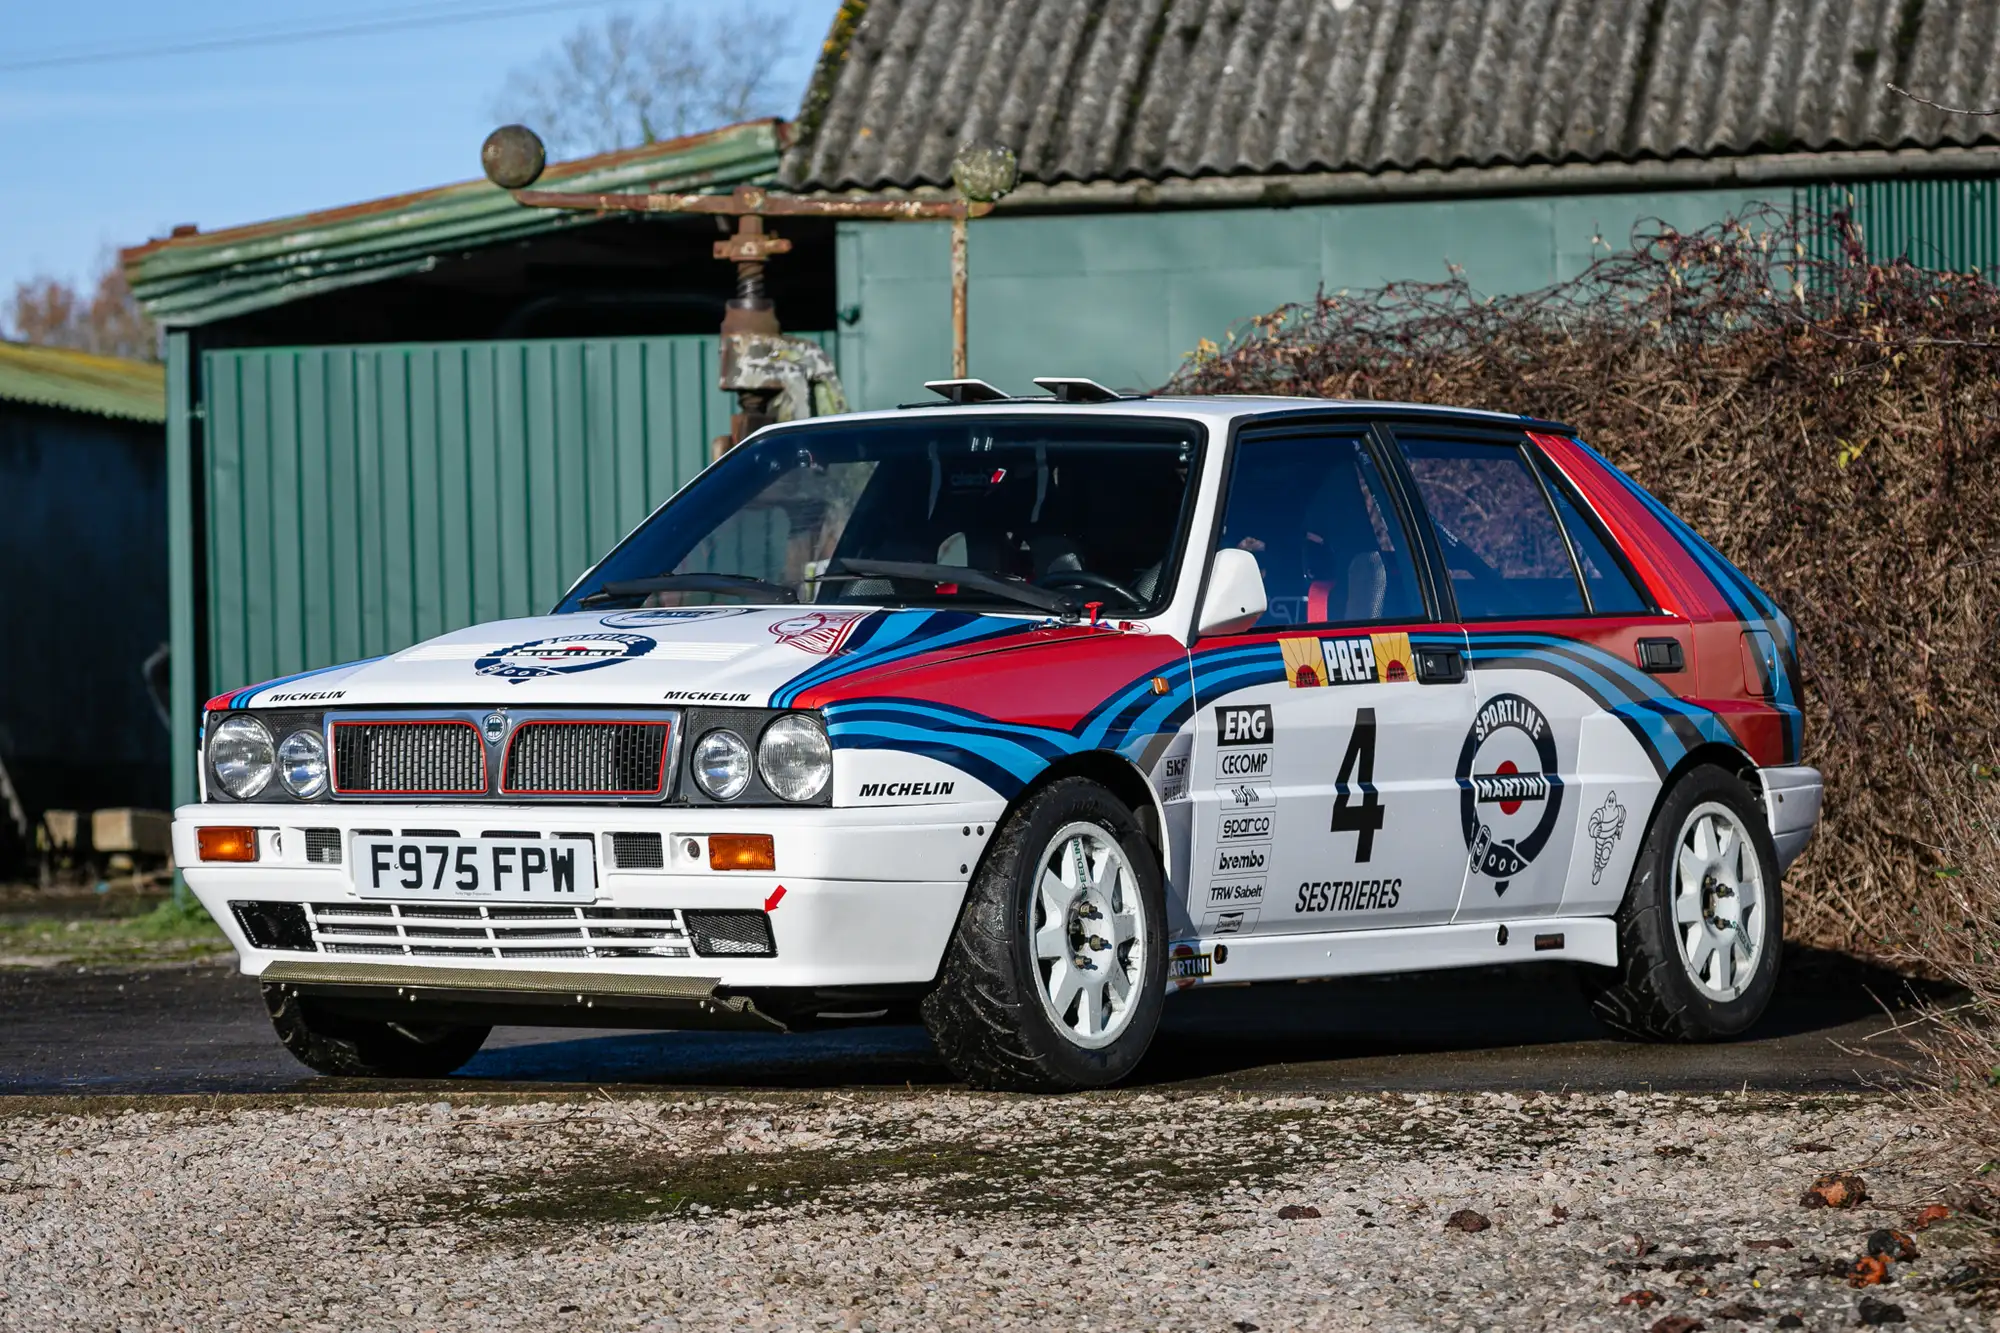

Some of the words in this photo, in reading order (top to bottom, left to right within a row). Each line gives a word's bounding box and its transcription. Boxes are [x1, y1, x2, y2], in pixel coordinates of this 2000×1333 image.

[1322, 639, 1376, 682] PREP
[269, 690, 347, 702] MICHELIN
[663, 691, 751, 702] MICHELIN
[1224, 709, 1266, 740] ERG
[1476, 699, 1544, 742] SPORTLINE
[1222, 753, 1268, 774] CECOMP
[859, 782, 955, 797] MICHELIN
[1330, 707, 1385, 863] 4
[1478, 776, 1545, 799] MARTINI
[1223, 817, 1270, 838] sparco
[370, 844, 479, 891] F975
[492, 846, 575, 893] FPW
[1073, 837, 1088, 898] SPEEDLINE
[1219, 850, 1265, 870] brembo
[1211, 885, 1235, 900] TRW
[1235, 884, 1263, 899] Sabelt
[1295, 878, 1402, 913] SESTRIERES
[1167, 956, 1210, 977] ARTINI
